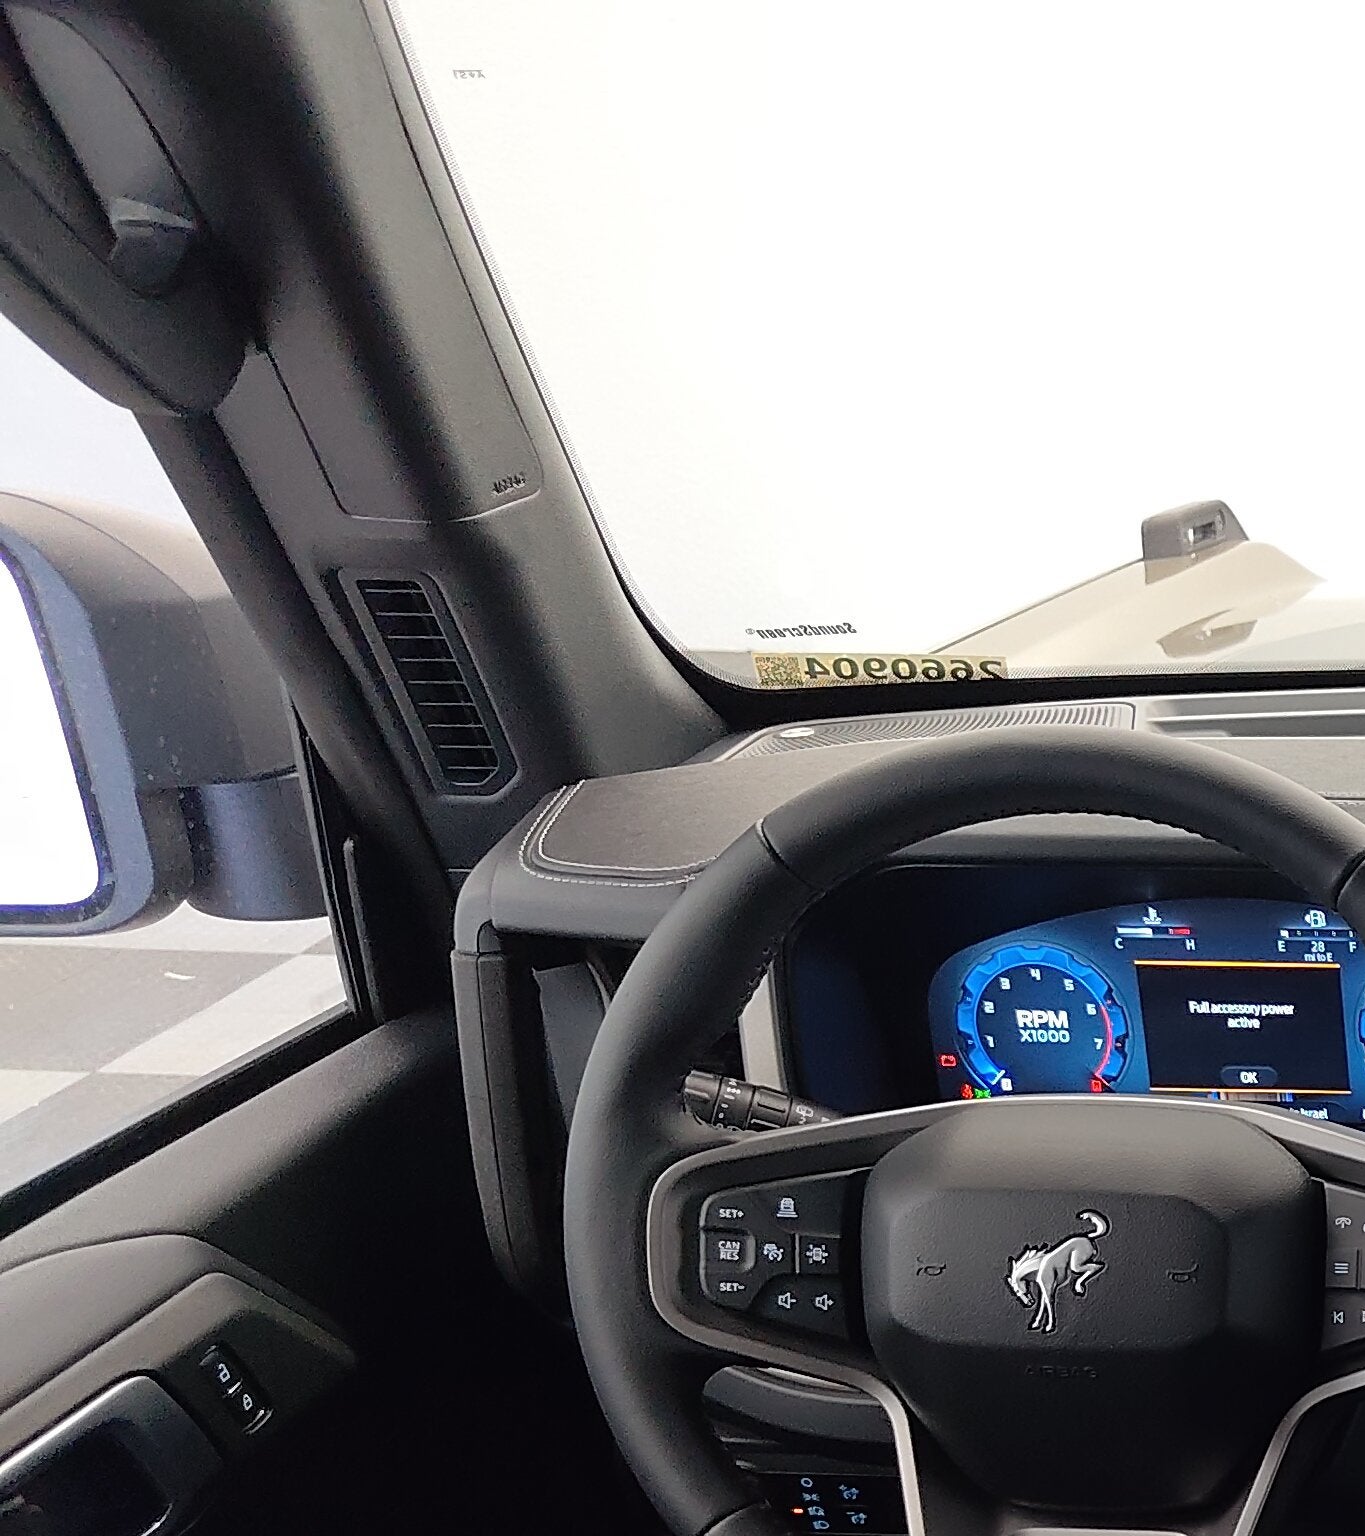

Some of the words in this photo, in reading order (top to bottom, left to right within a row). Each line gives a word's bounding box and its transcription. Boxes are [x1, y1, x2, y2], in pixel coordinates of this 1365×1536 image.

[1114, 938, 1124, 950] C
[1185, 939, 1196, 951] H
[1278, 940, 1286, 952] E
[1310, 941, 1325, 953] 28
[1349, 941, 1357, 952] F
[1063, 979, 1075, 991] 5
[983, 1001, 995, 1014] 2
[1086, 1003, 1097, 1016] 6
[1188, 1000, 1210, 1014] Full
[1210, 1003, 1261, 1017] accessory
[1261, 1003, 1295, 1017] power
[1015, 1009, 1069, 1029] RPM
[1227, 1016, 1261, 1029] active
[1020, 1029, 1071, 1043] X1000
[1094, 1038, 1104, 1050] 7
[1239, 1070, 1259, 1085] OK
[718, 1240, 740, 1250] CAN
[719, 1251, 740, 1260] RES
